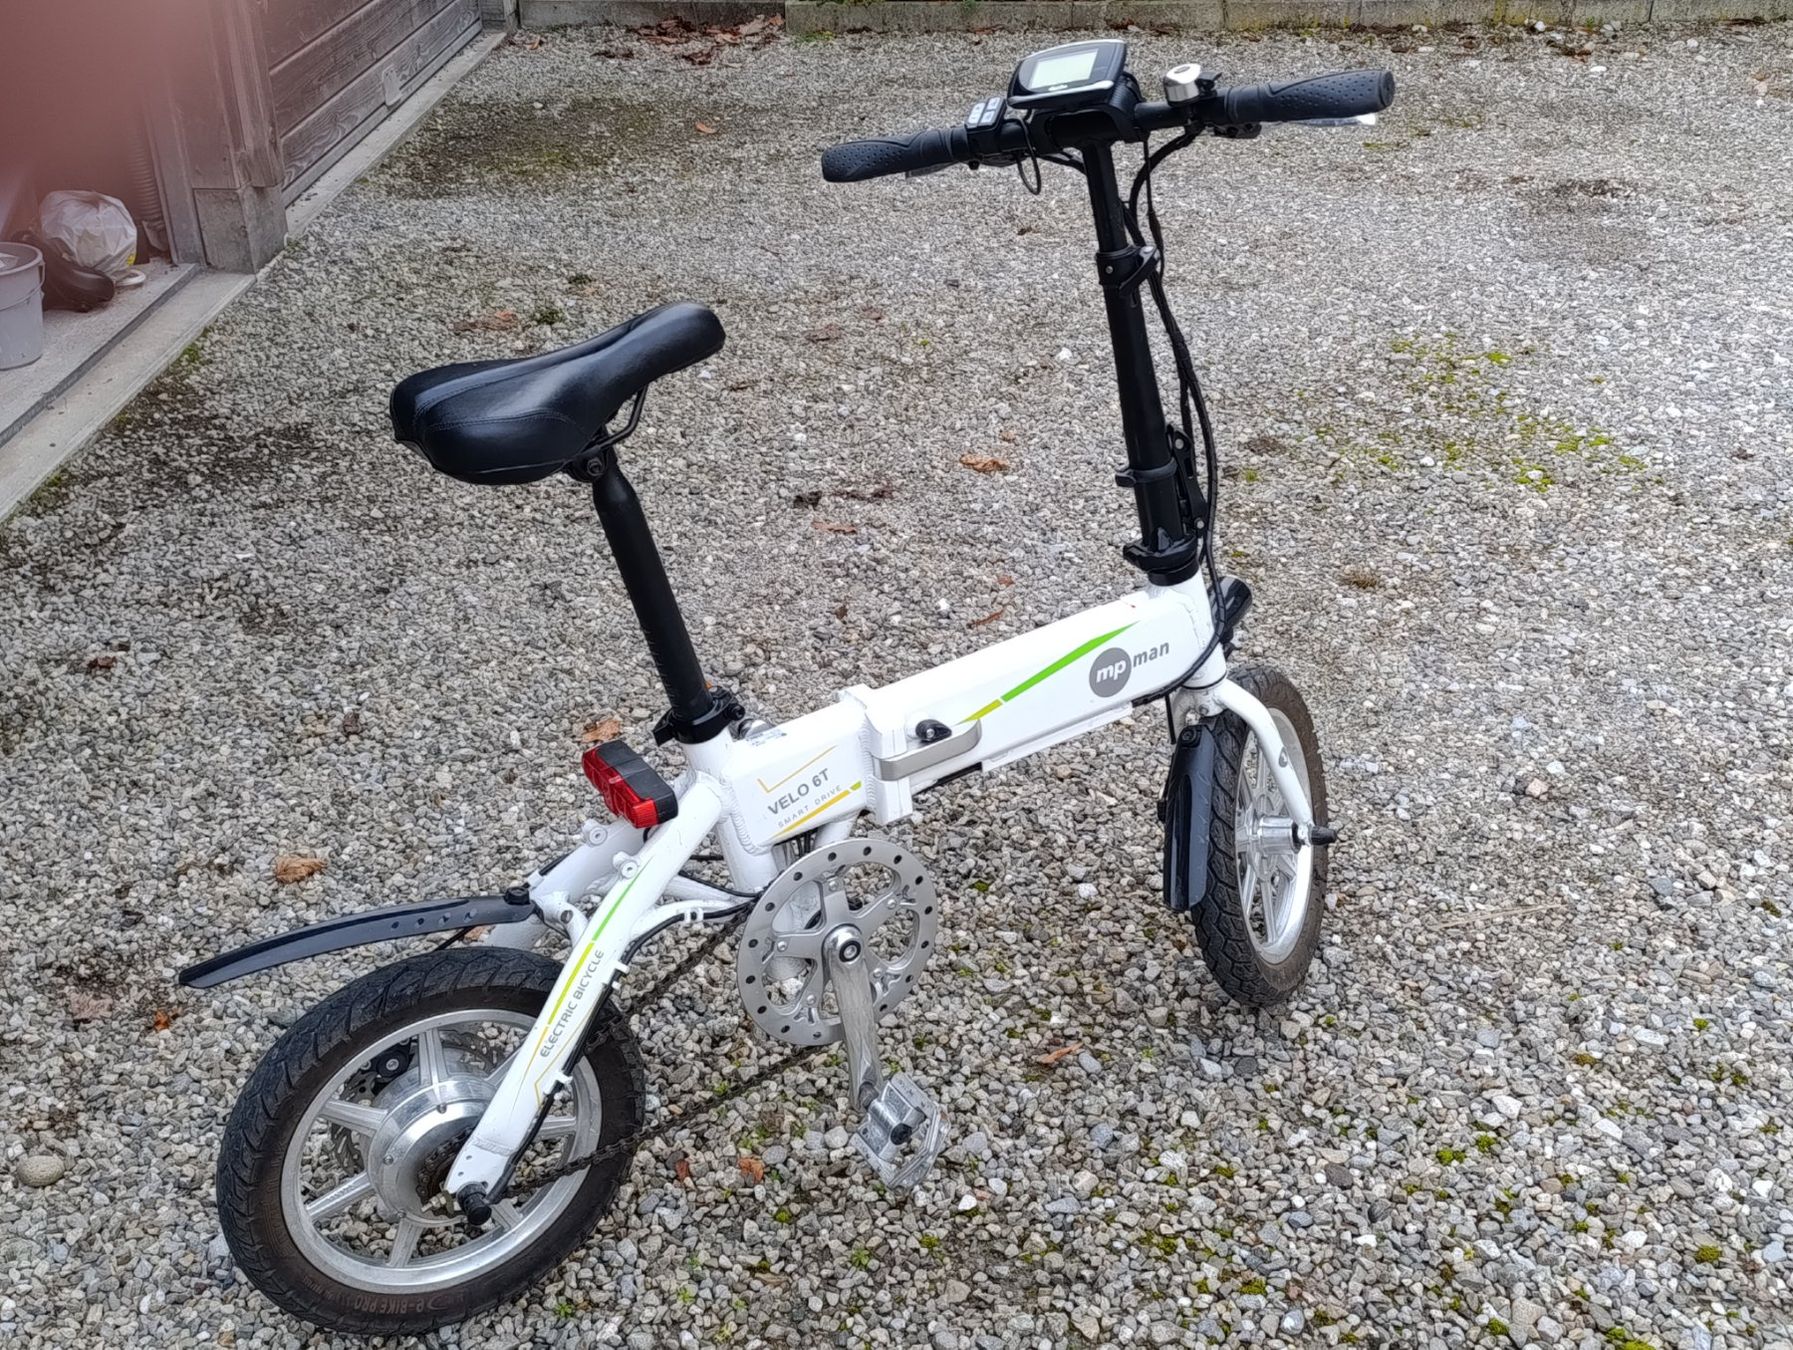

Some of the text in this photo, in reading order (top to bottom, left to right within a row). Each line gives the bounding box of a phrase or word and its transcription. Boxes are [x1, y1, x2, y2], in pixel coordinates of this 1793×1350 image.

[1133, 642, 1169, 668] man
[768, 768, 829, 815] VELO 6T
[778, 785, 841, 828] SMART DRIVE
[540, 950, 604, 1058] ELECTRIC BICYCLE
